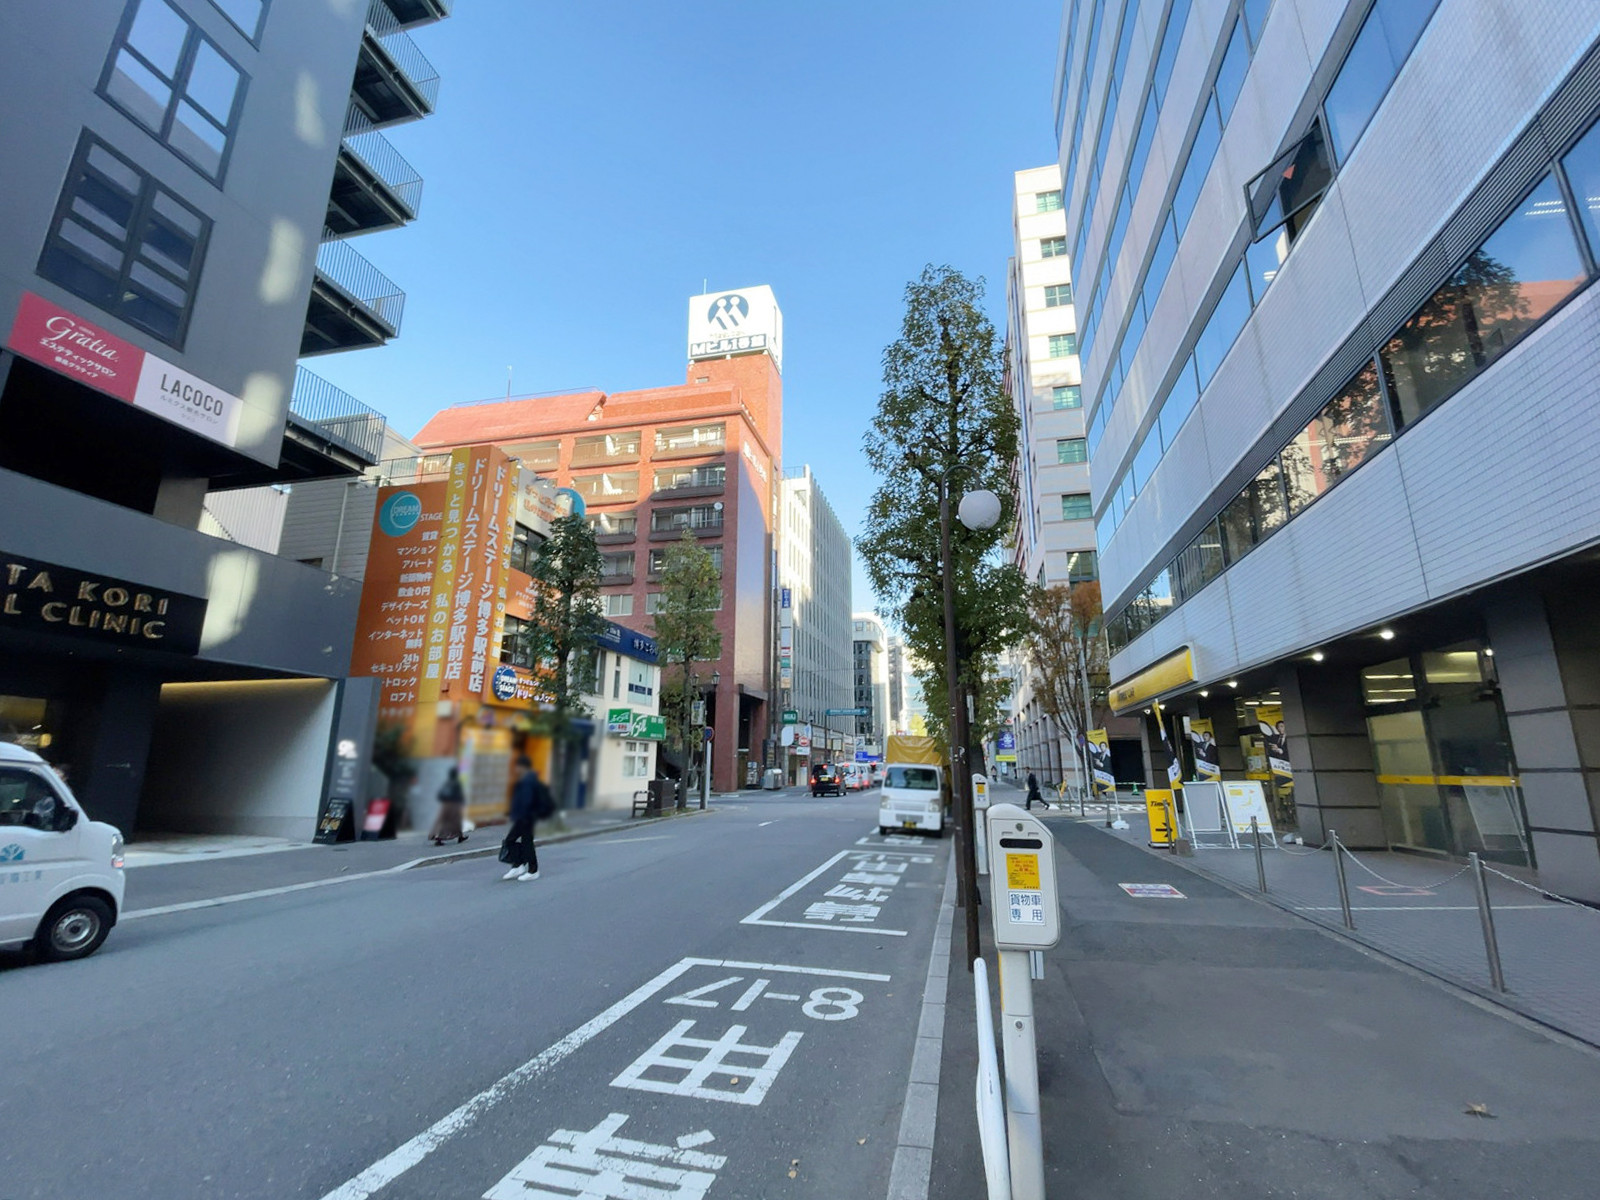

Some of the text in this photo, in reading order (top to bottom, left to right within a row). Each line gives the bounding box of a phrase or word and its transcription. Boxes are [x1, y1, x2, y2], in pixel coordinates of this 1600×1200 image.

[161, 373, 224, 416] LACOCO
[421, 512, 443, 521] STAGE
[397, 545, 437, 556] マンション
[402, 558, 434, 570] アパート
[425, 461, 466, 679] きっと見つかる、私のお部屋
[444, 458, 487, 680] ドリームステージ博多駅前店
[468, 465, 506, 694] ドリームステージ博多駅前店
[77, 580, 169, 616] KORI
[381, 599, 429, 612] デザイナーズ
[41, 602, 166, 639] CLINIC
[368, 628, 424, 640] インターネット
[402, 653, 419, 662] 24h
[371, 661, 419, 673] セキュリティ
[382, 676, 418, 688] トロック
[389, 691, 415, 702] ロフト
[1010, 893, 1042, 907] 貨物車
